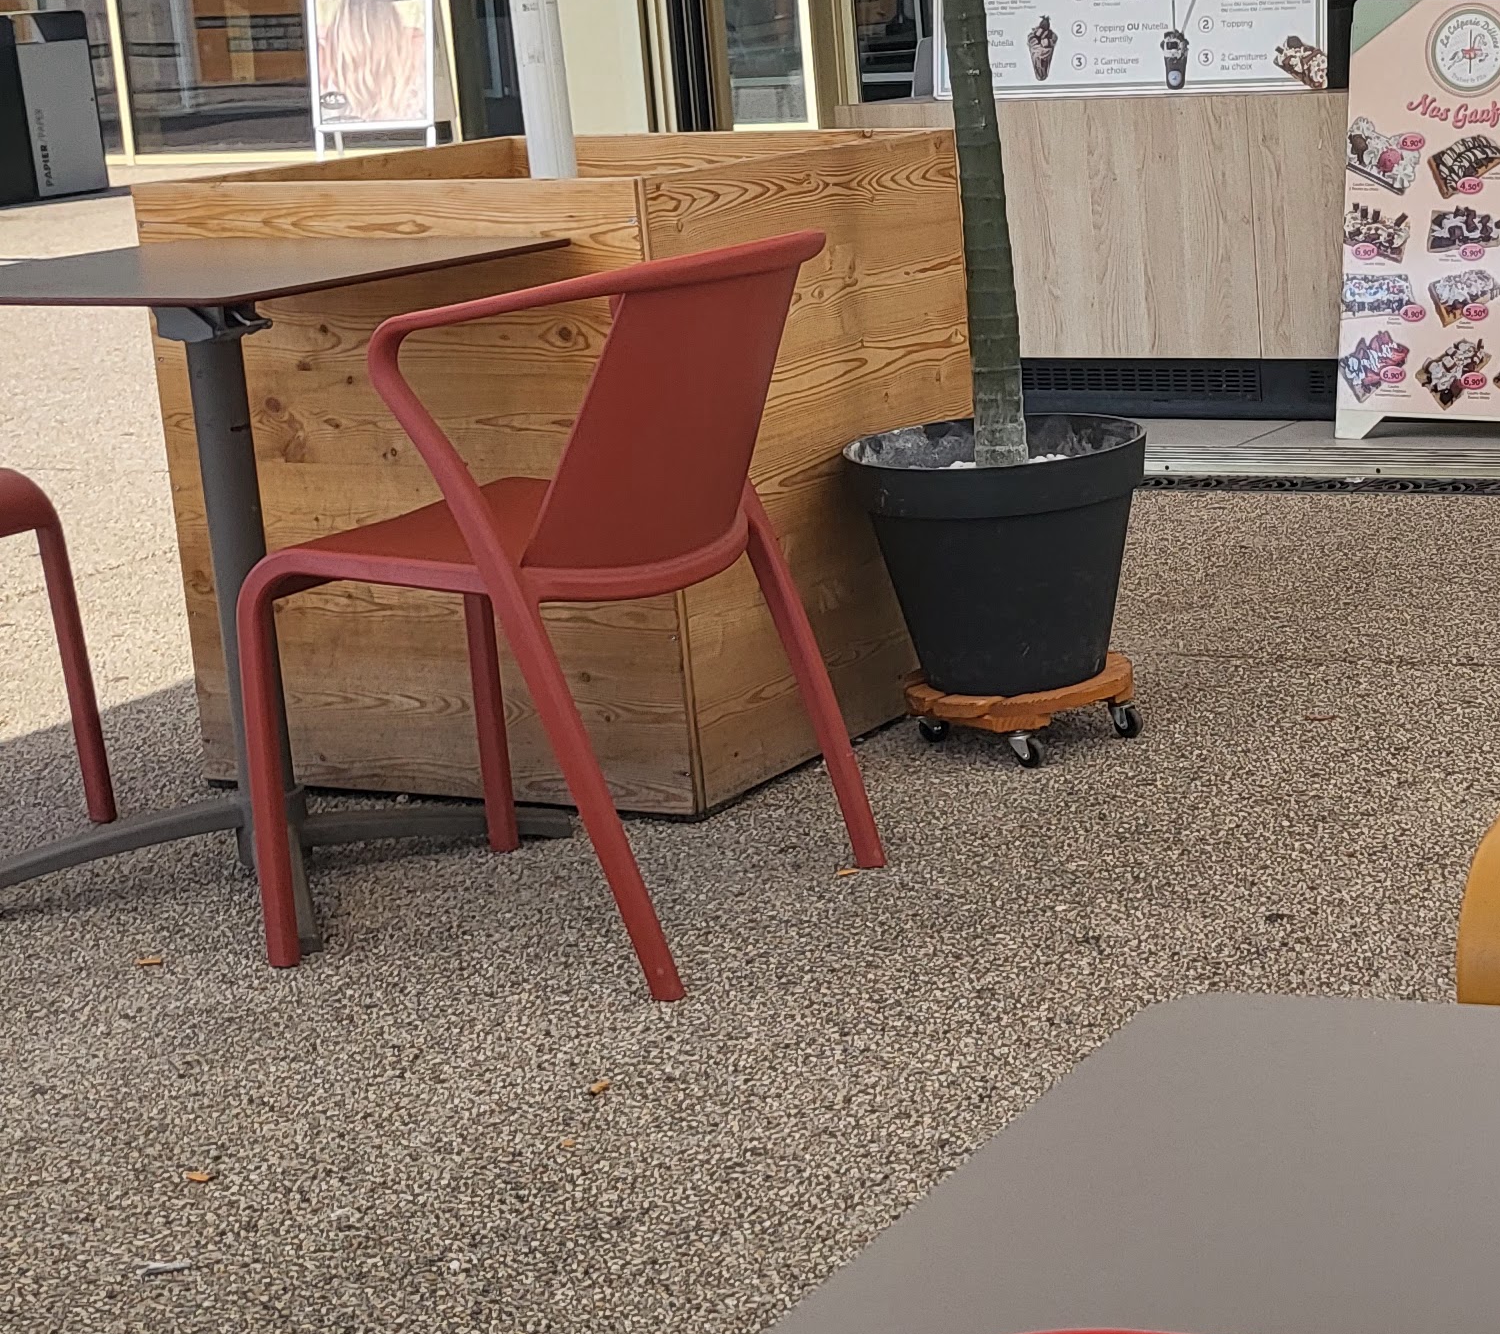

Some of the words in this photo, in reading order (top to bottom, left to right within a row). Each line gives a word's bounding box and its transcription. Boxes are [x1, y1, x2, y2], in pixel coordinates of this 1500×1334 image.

[1094, 24, 1125, 33] Topping
[1126, 23, 1140, 31] OU
[1141, 22, 1169, 31] Nutella
[1221, 20, 1253, 29] Topping
[1440, 35, 1451, 48] La
[1447, 17, 1481, 35] Crêperie
[1480, 20, 1500, 49] Délices
[1099, 34, 1133, 45] Chantilly
[1100, 56, 1139, 65] Garnitures
[1227, 52, 1268, 61] Garnitures
[1106, 66, 1127, 75] choix
[1231, 62, 1253, 71] choix
[1406, 93, 1451, 121] Nos
[40, 144, 55, 187] PAPIER
